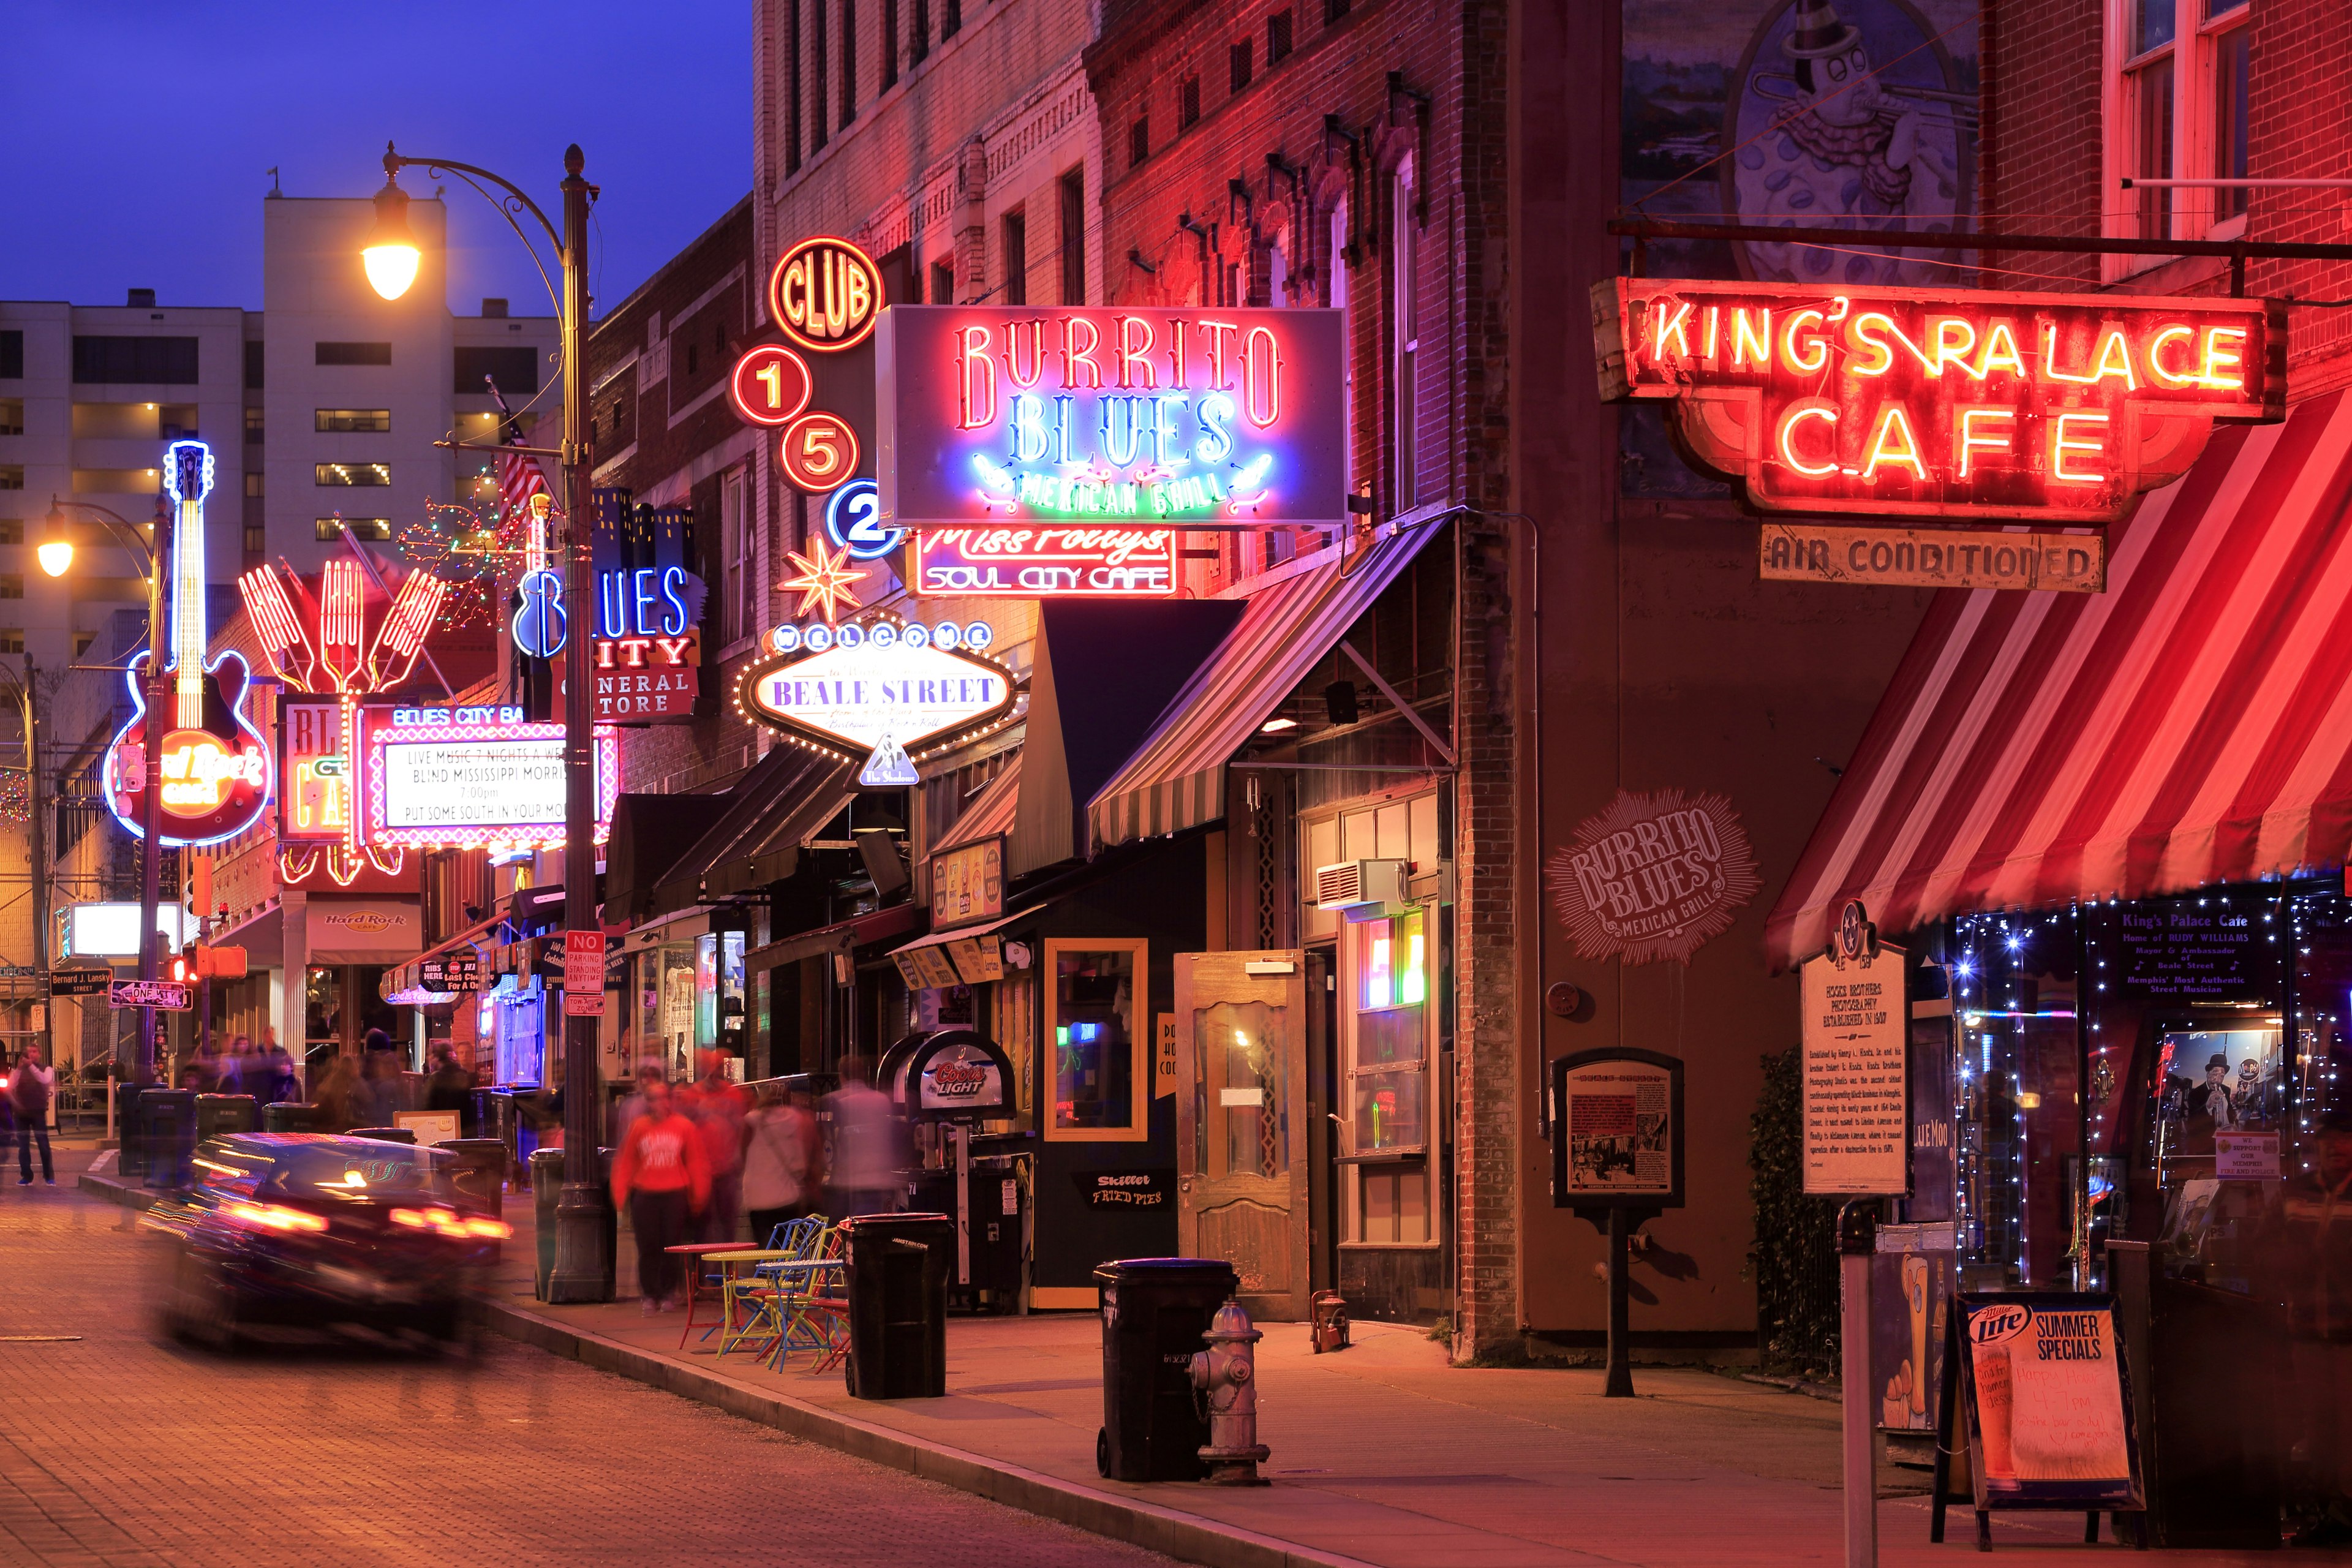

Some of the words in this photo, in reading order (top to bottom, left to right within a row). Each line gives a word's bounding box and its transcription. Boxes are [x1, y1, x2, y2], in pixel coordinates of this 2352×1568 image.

[782, 249, 871, 337] CLUB
[1652, 296, 1896, 379] KING'S
[1925, 314, 2249, 392] PALACE
[954, 314, 1286, 431] BURRITO
[755, 361, 781, 409] 1
[1008, 391, 1237, 470] BLUES
[1775, 396, 2111, 484] CAFE
[801, 428, 839, 475] 5
[1018, 470, 1137, 515] MEXICAN
[1151, 473, 1227, 514] GRILL
[848, 493, 886, 541] 2
[1770, 535, 1830, 570] AIR
[1849, 540, 2091, 580] CONDITIONED
[926, 567, 1012, 589] SOUL
[1018, 567, 1083, 589] CITY
[1089, 567, 1170, 589] CAFE
[540, 565, 688, 658] BUES
[776, 626, 989, 649] WELCOME
[773, 680, 869, 706] BEALE
[882, 679, 994, 704] STREET
[599, 695, 668, 714] TORE
[393, 708, 451, 726] BLUES
[455, 707, 496, 725] CITY
[408, 751, 431, 764] LIVE
[437, 749, 471, 764] MUSIC
[488, 748, 528, 762] NIGHTS
[413, 769, 448, 783] BLIND
[454, 767, 518, 782] MISSISSIPPI
[865, 769, 881, 783] The
[882, 768, 916, 783] Shadows
[405, 806, 424, 821] PUT
[428, 805, 456, 820] SOME
[461, 804, 494, 820] SOUTH
[499, 804, 510, 818] IN
[513, 804, 541, 818] YOUR
[1570, 808, 1722, 911] BURRITO
[1604, 850, 1709, 917] BLUES
[325, 915, 365, 924] Hard
[368, 915, 407, 925] Rock
[1623, 910, 1678, 937] MEXICAN
[1679, 891, 1716, 919] GRILL
[2123, 914, 2163, 929] King's
[2170, 914, 2211, 927] Palace
[2219, 914, 2248, 927] Cafe
[574, 935, 597, 949] NO
[2123, 933, 2147, 942] Home
[2153, 933, 2163, 942] of
[2169, 933, 2194, 942] RUDY
[2200, 933, 2249, 942] WILLIAMS
[569, 954, 599, 963] PARKING
[53, 974, 78, 984] Bernard
[80, 974, 86, 983] J.
[88, 973, 110, 984] Lansky
[568, 965, 601, 974] STANDING
[568, 974, 600, 982] ANYTIME
[2128, 976, 2169, 985] Memphis'
[134, 989, 153, 998] ONE
[1826, 985, 1847, 998] HOOKS
[1850, 983, 1882, 997] BROTHERS
[1831, 998, 1877, 1012] PHOTOGRAPHY
[1823, 1013, 1863, 1027] ESTABLISHED
[1866, 1012, 1872, 1025] IN
[935, 1061, 985, 1084] Coors
[938, 1082, 982, 1095] LIGHT
[1097, 1175, 1150, 1186] Skillet
[1093, 1189, 1132, 1204] FRIED
[1133, 1191, 1162, 1205] PIES
[1980, 1306, 2014, 1319] Miller
[1977, 1313, 2022, 1344] Lite
[2035, 1315, 2099, 1338] SUMMER
[2037, 1338, 2102, 1360] SPECIALS
[1978, 1367, 1994, 1380] and
[2016, 1368, 2059, 1389] Happy
